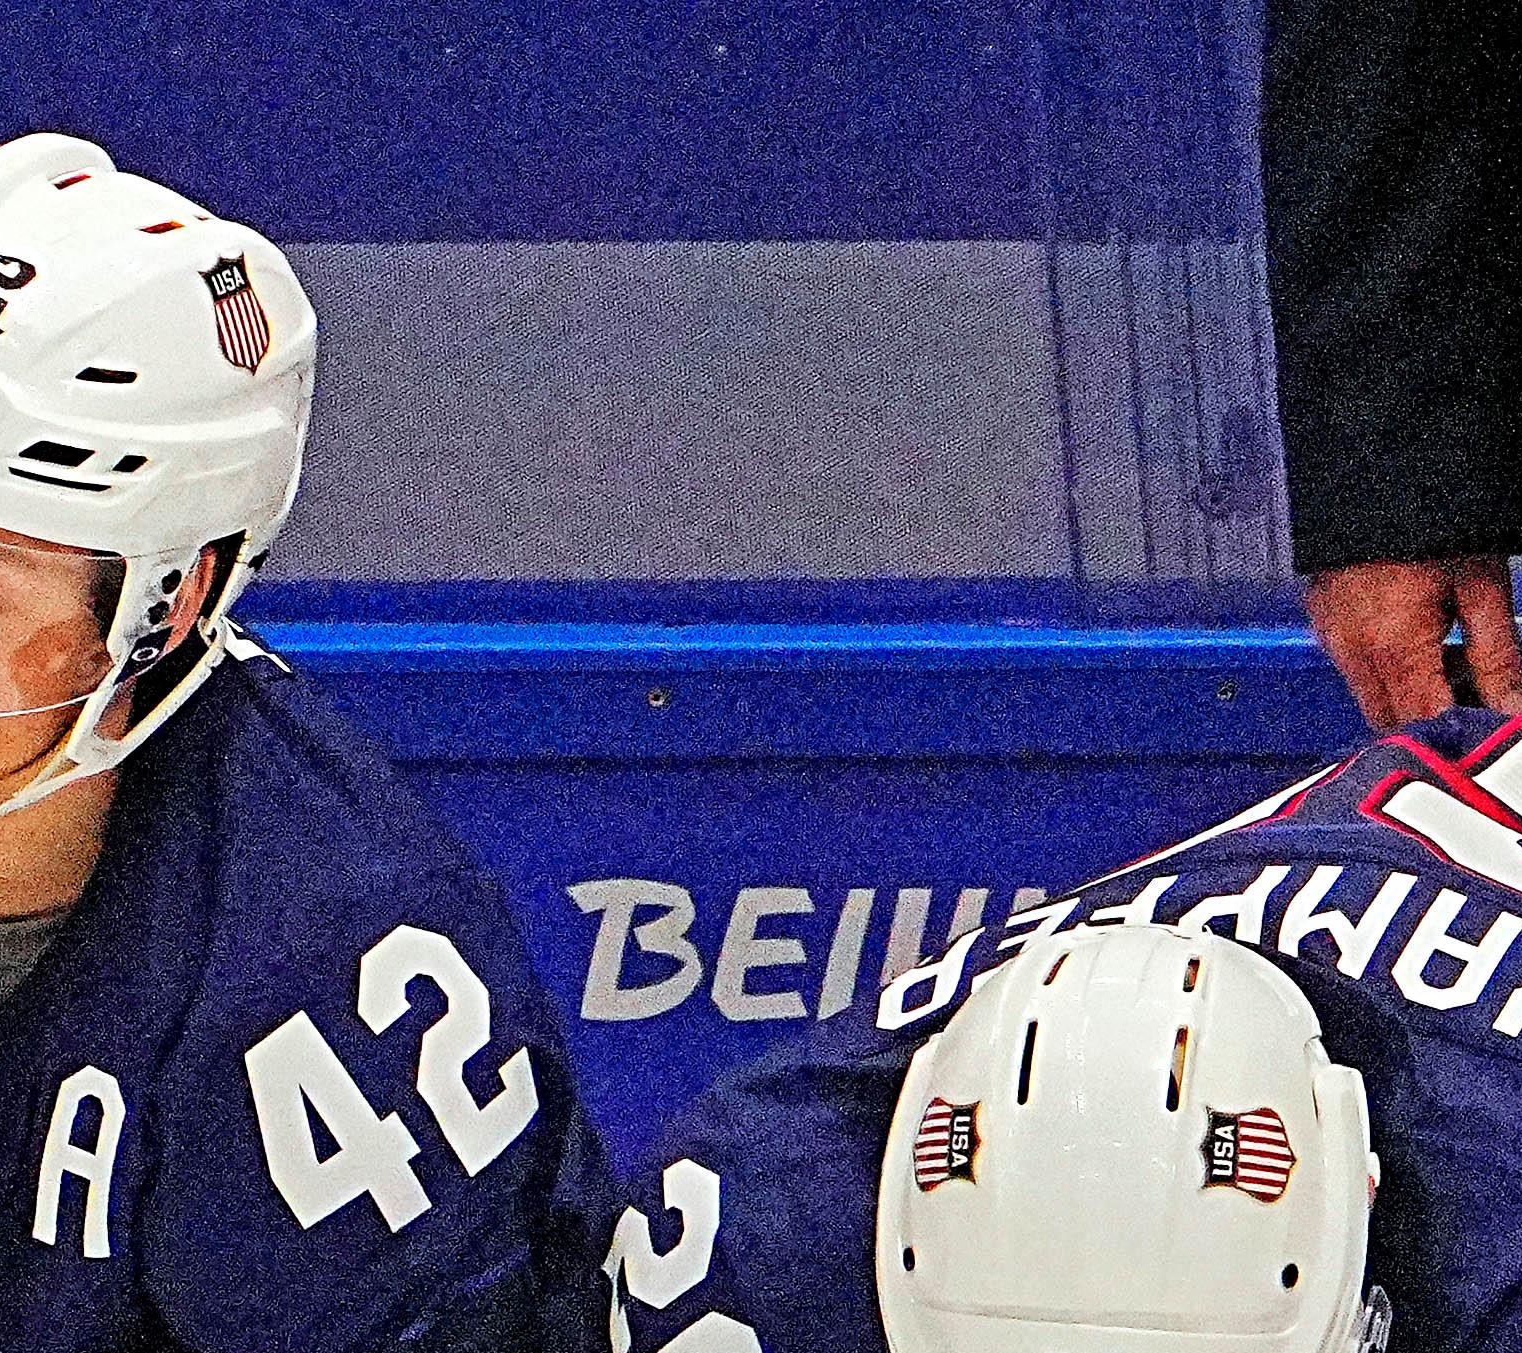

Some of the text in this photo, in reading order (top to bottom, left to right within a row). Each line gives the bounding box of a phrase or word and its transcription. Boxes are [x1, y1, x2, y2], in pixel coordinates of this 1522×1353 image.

[211, 266, 245, 295] USA
[244, 924, 540, 1233] 42
[31, 1065, 127, 1258] A
[950, 1115, 971, 1168] USA
[1213, 1124, 1237, 1176] USA
